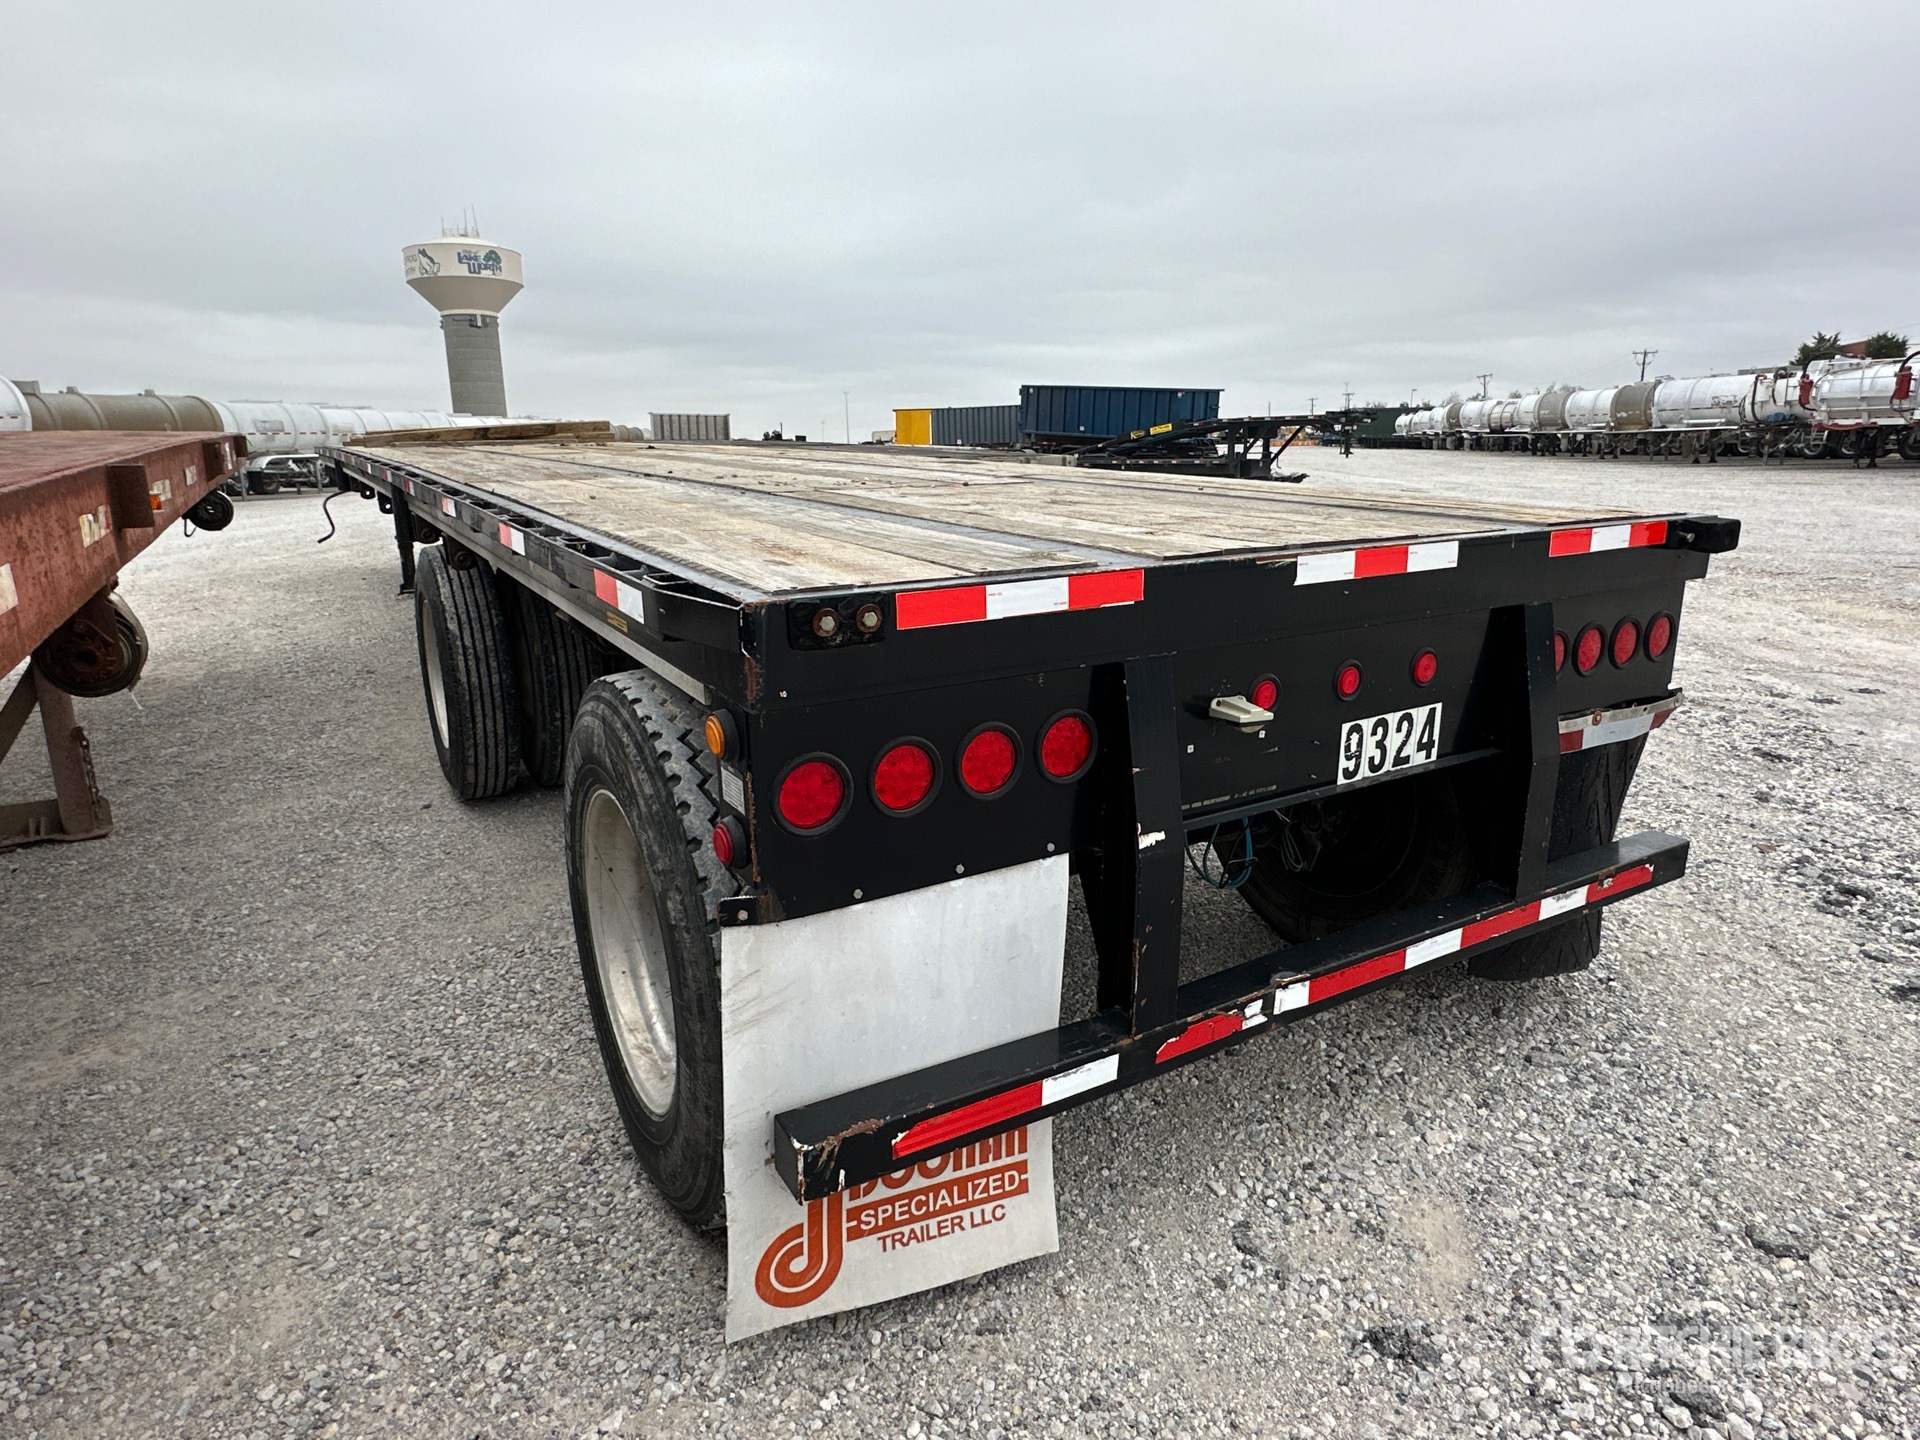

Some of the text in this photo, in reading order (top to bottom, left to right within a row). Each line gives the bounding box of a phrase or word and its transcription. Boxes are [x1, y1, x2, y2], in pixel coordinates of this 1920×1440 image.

[1342, 706, 1438, 781] 9324
[877, 1204, 1006, 1253] TRAILER LLC
